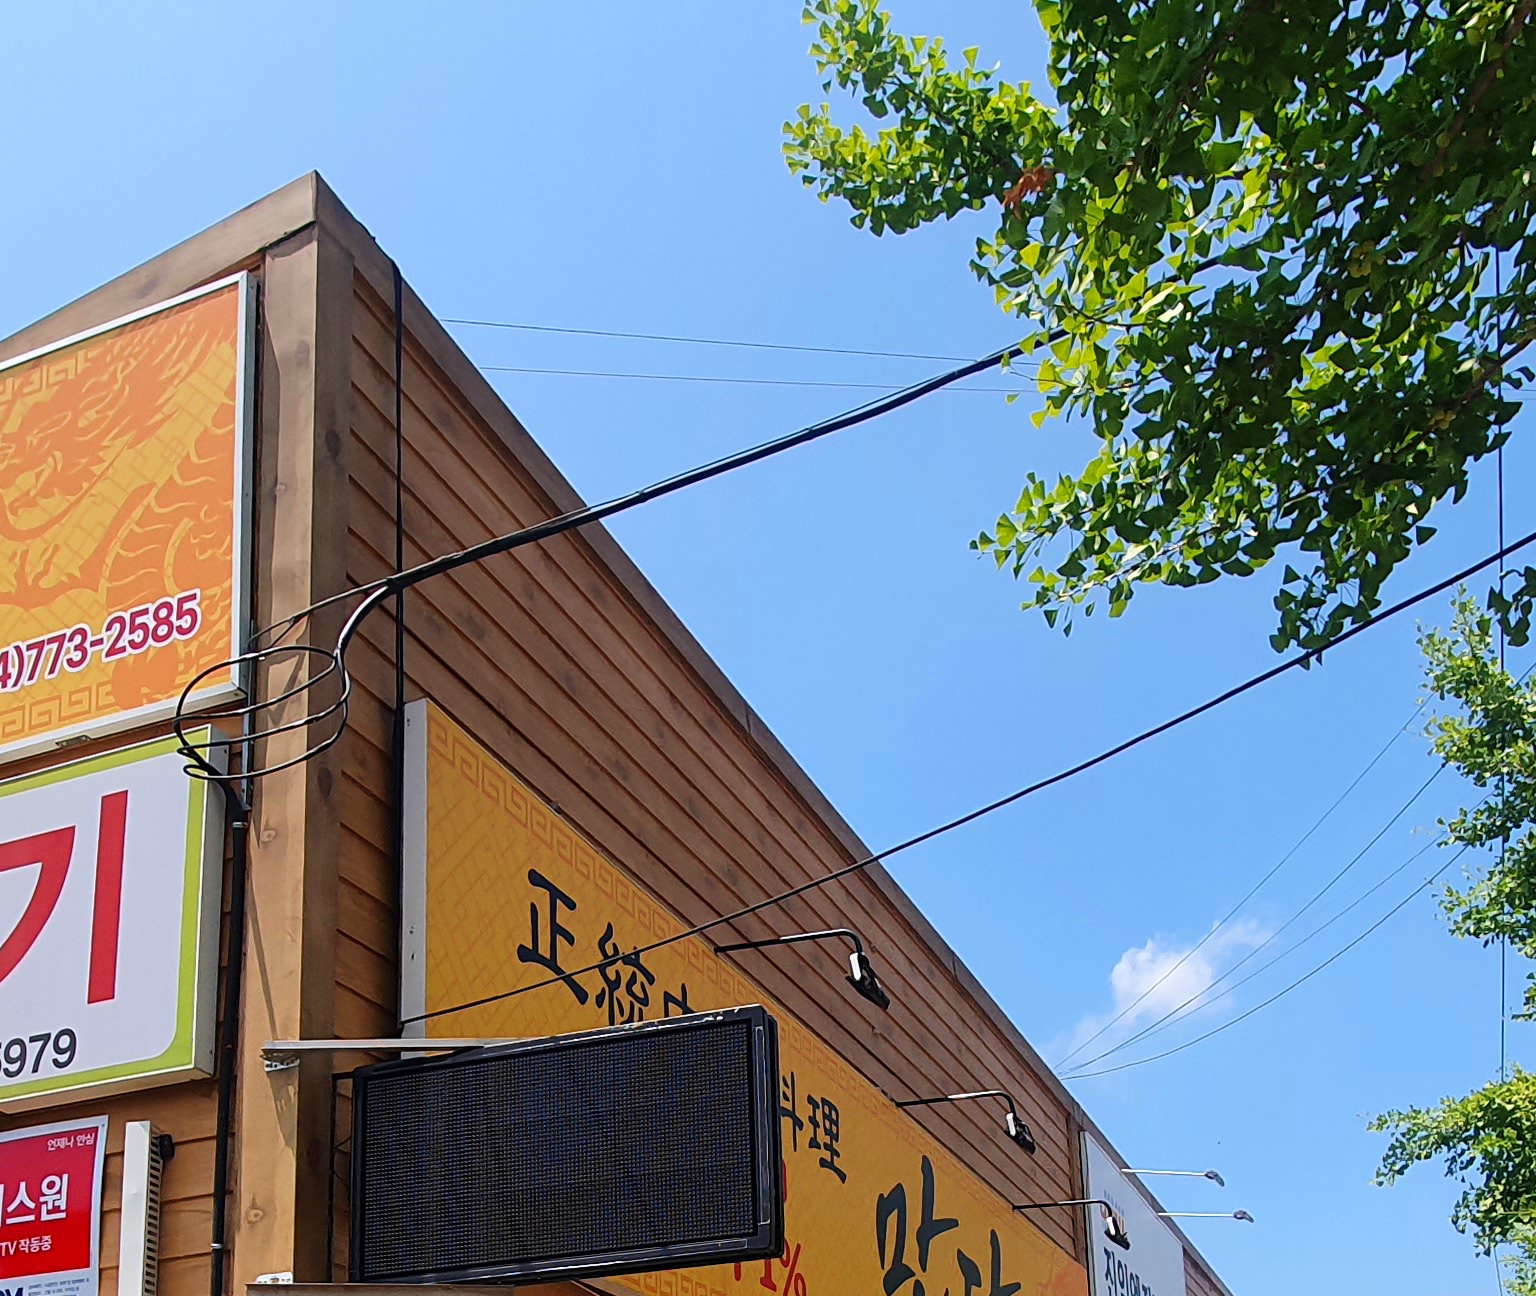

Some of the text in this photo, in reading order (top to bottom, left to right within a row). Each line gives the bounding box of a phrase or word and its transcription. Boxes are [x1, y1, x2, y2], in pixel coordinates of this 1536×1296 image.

[47, 1132, 95, 1151] 언제나 안심
[18, 1235, 52, 1254] 작동중
